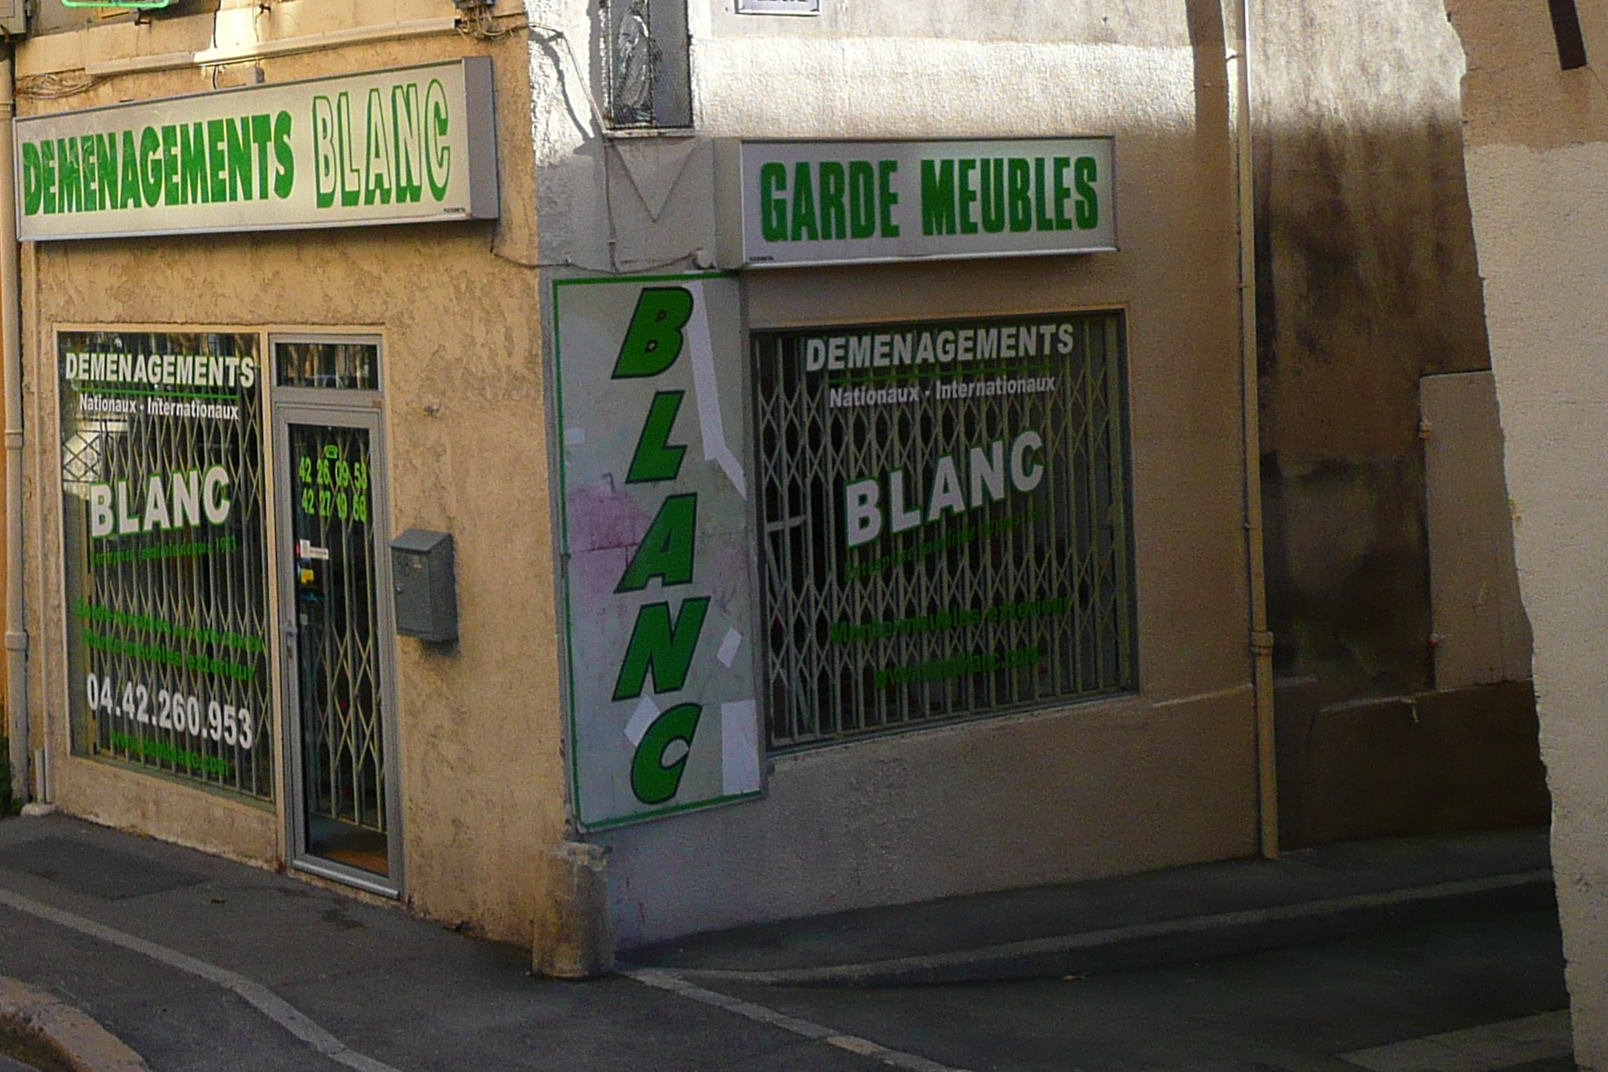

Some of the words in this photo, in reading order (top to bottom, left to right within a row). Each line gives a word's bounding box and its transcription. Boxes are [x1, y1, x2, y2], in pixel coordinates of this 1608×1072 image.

[22, 111, 294, 216] DEMENAGEMENTS
[312, 78, 451, 209] BLANC
[760, 160, 900, 242] GARDE
[920, 156, 1099, 236] MEUBLES
[65, 352, 255, 388] DEMENAGEMENTS
[805, 324, 1074, 372] DEMENAGEMENTS
[79, 393, 136, 414] Nationaux
[147, 396, 239, 420] Internationaux
[829, 384, 921, 408] Nationaux
[935, 376, 1056, 401] Internationaux
[91, 465, 232, 538] BLANC
[299, 457, 312, 483] 42
[317, 459, 330, 484] 26
[335, 460, 349, 487] 09
[846, 430, 1045, 548] BLANC
[301, 488, 314, 515] 42
[319, 491, 331, 517] 27
[611, 287, 711, 805] BLANC
[86, 672, 253, 749] 04.42.260.953
